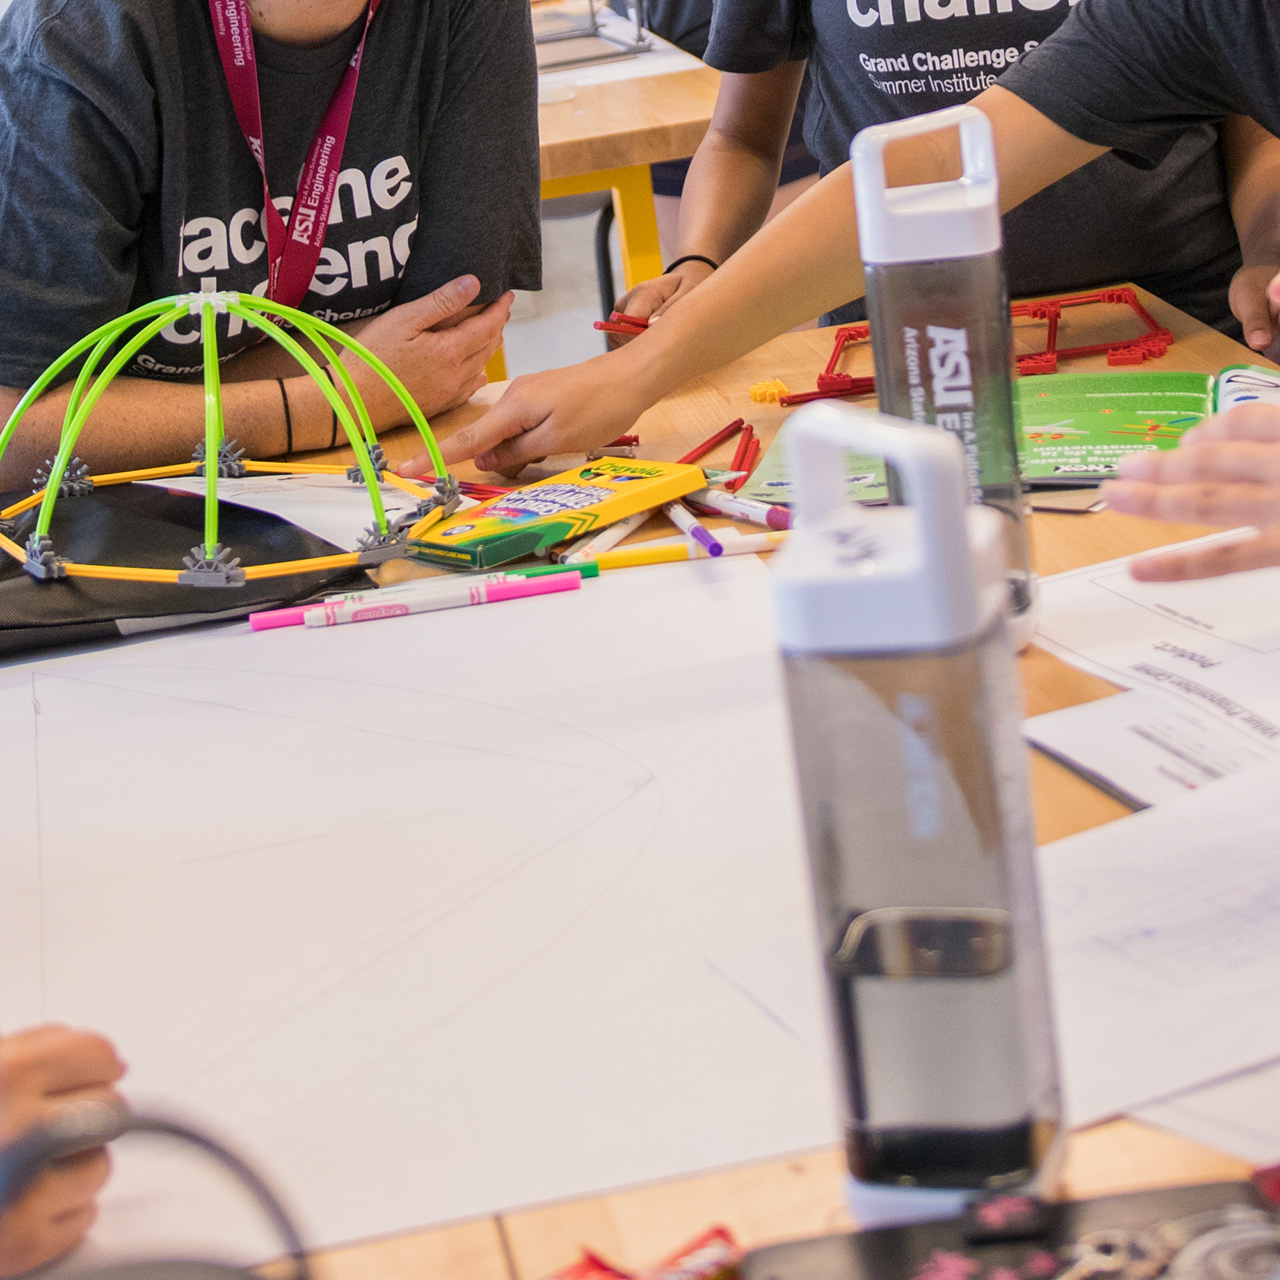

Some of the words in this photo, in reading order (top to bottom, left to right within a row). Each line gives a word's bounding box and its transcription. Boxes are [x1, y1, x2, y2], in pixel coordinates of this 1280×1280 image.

[215, 1, 226, 36] University
[859, 52, 910, 73] Grand
[912, 46, 1019, 72] Challenge
[308, 135, 336, 207] Engineering
[324, 169, 338, 204] University
[292, 207, 317, 245] ASU
[903, 326, 921, 387] Arizona
[926, 325, 975, 408] ASU
[1033, 443, 1158, 453] Construction
[594, 463, 664, 476] Crayola
